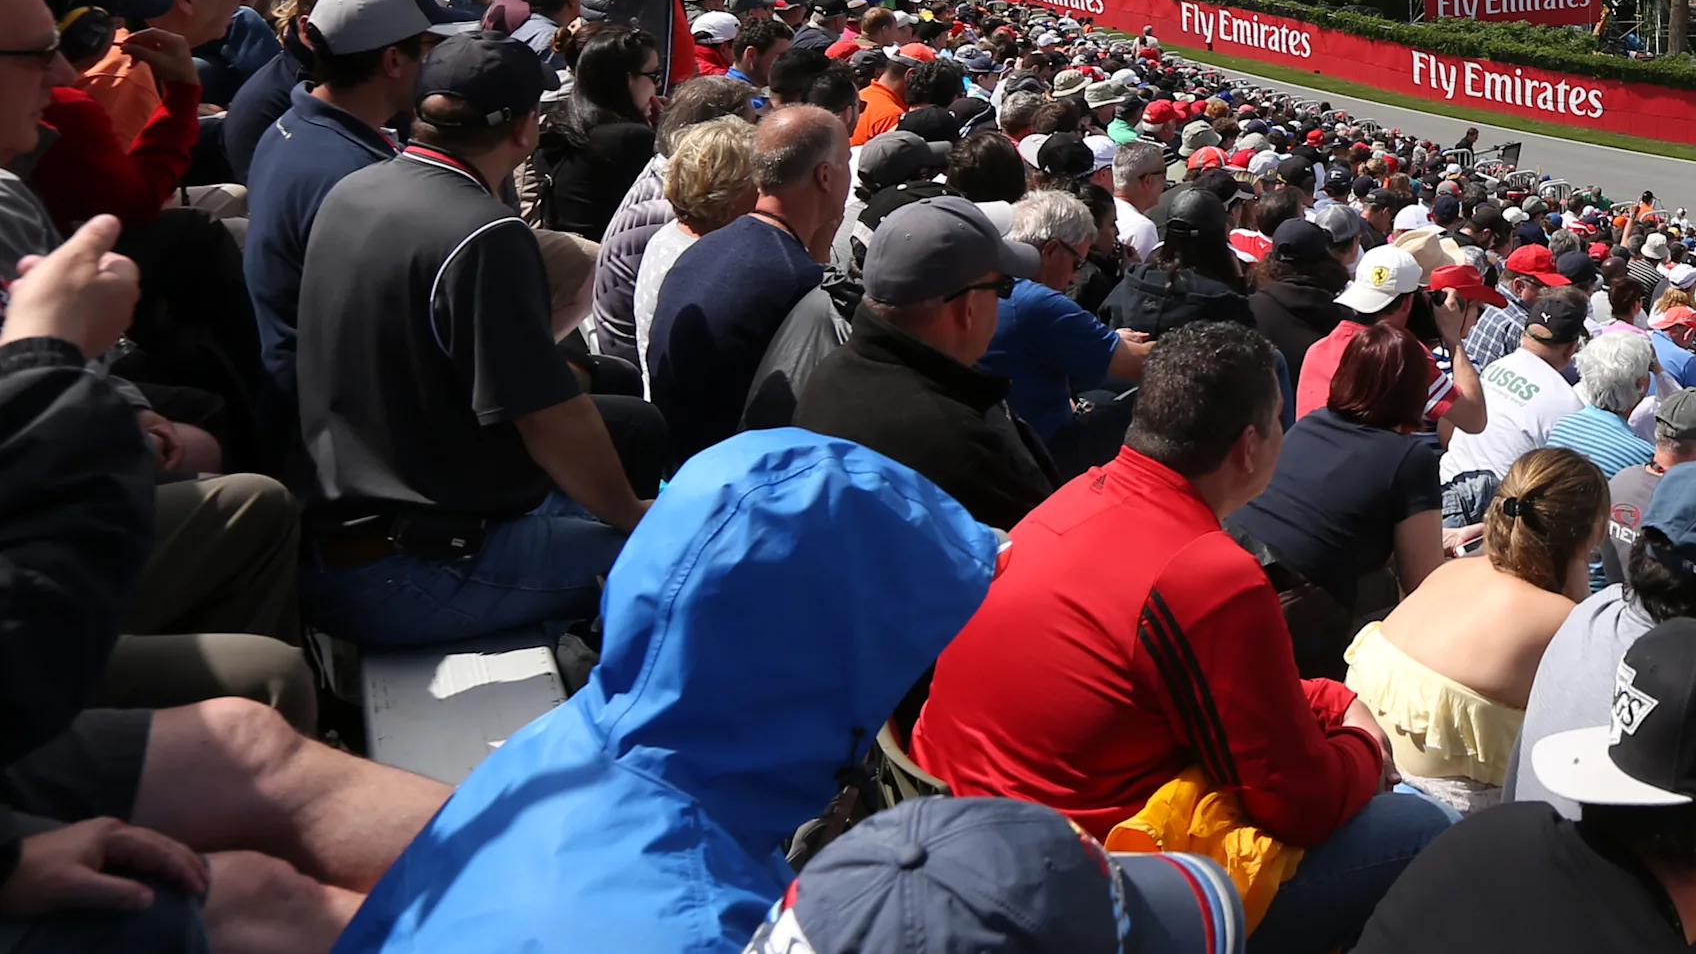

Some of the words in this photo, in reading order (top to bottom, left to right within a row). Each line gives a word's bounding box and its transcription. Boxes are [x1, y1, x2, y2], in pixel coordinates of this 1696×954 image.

[1181, 1, 1215, 44] Fly
[1218, 9, 1312, 59] Emirates
[1411, 50, 1457, 99] Fly
[1463, 61, 1604, 119] Emirates
[1487, 366, 1540, 401] USGS
